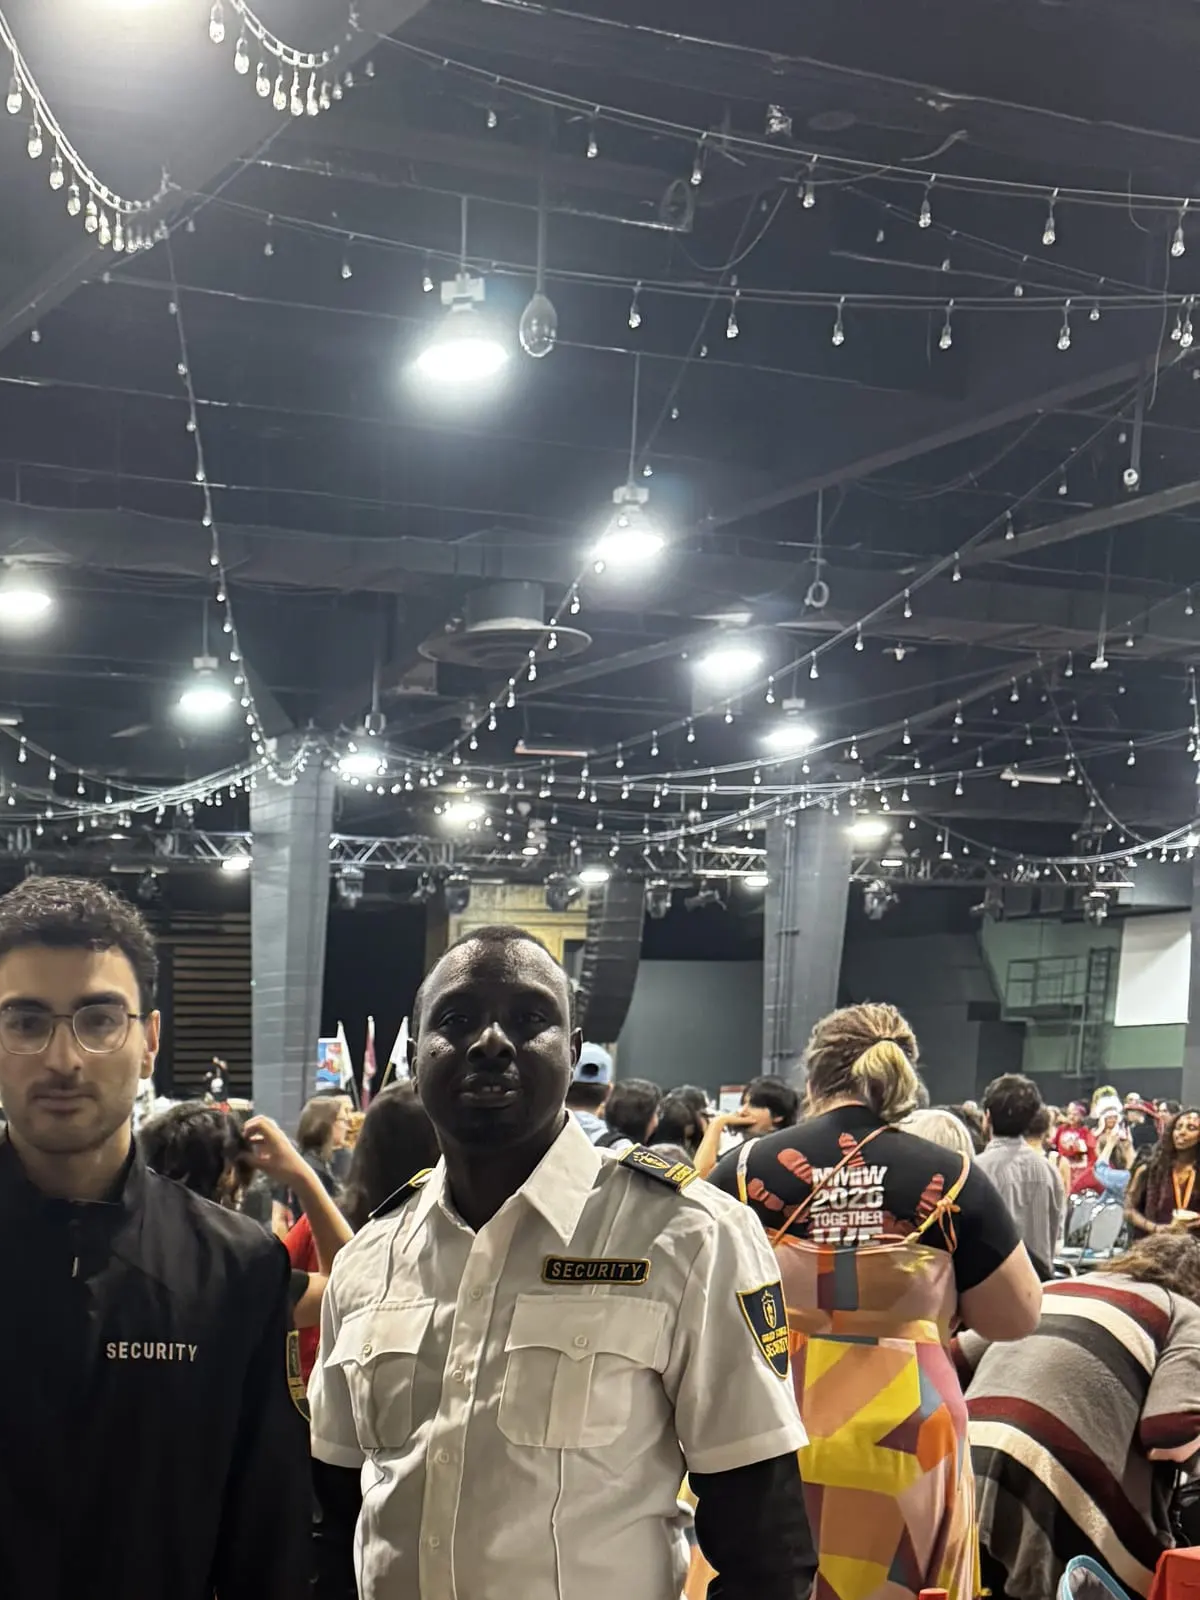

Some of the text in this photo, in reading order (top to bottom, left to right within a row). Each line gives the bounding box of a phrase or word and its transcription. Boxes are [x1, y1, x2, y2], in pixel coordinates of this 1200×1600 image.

[809, 1210, 884, 1227] TOGETHER
[551, 1262, 641, 1279] SECURITY
[106, 1342, 198, 1362] SECURITY
